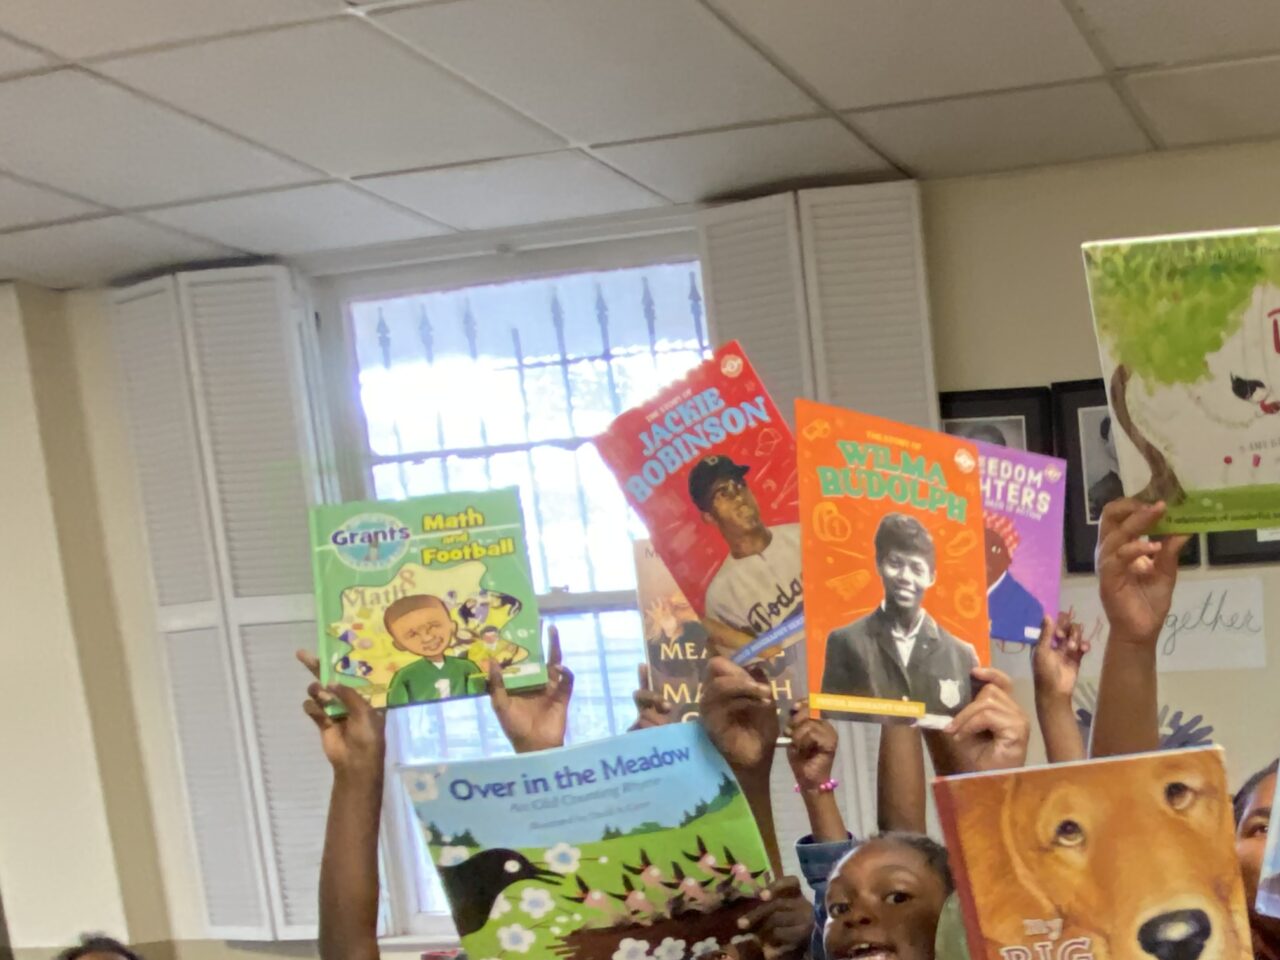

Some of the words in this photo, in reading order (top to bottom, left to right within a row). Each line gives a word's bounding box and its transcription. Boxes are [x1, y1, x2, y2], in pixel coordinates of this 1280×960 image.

[625, 396, 772, 503] ROBINSON
[639, 387, 725, 457] JACKIE
[836, 440, 949, 490] WILMA
[423, 506, 485, 532] Math
[816, 466, 969, 525] RUDOLPH
[422, 537, 515, 566] Football
[448, 777, 516, 801] Over
[521, 773, 551, 794] in
[554, 765, 597, 790] the
[600, 746, 690, 781] Meadow
